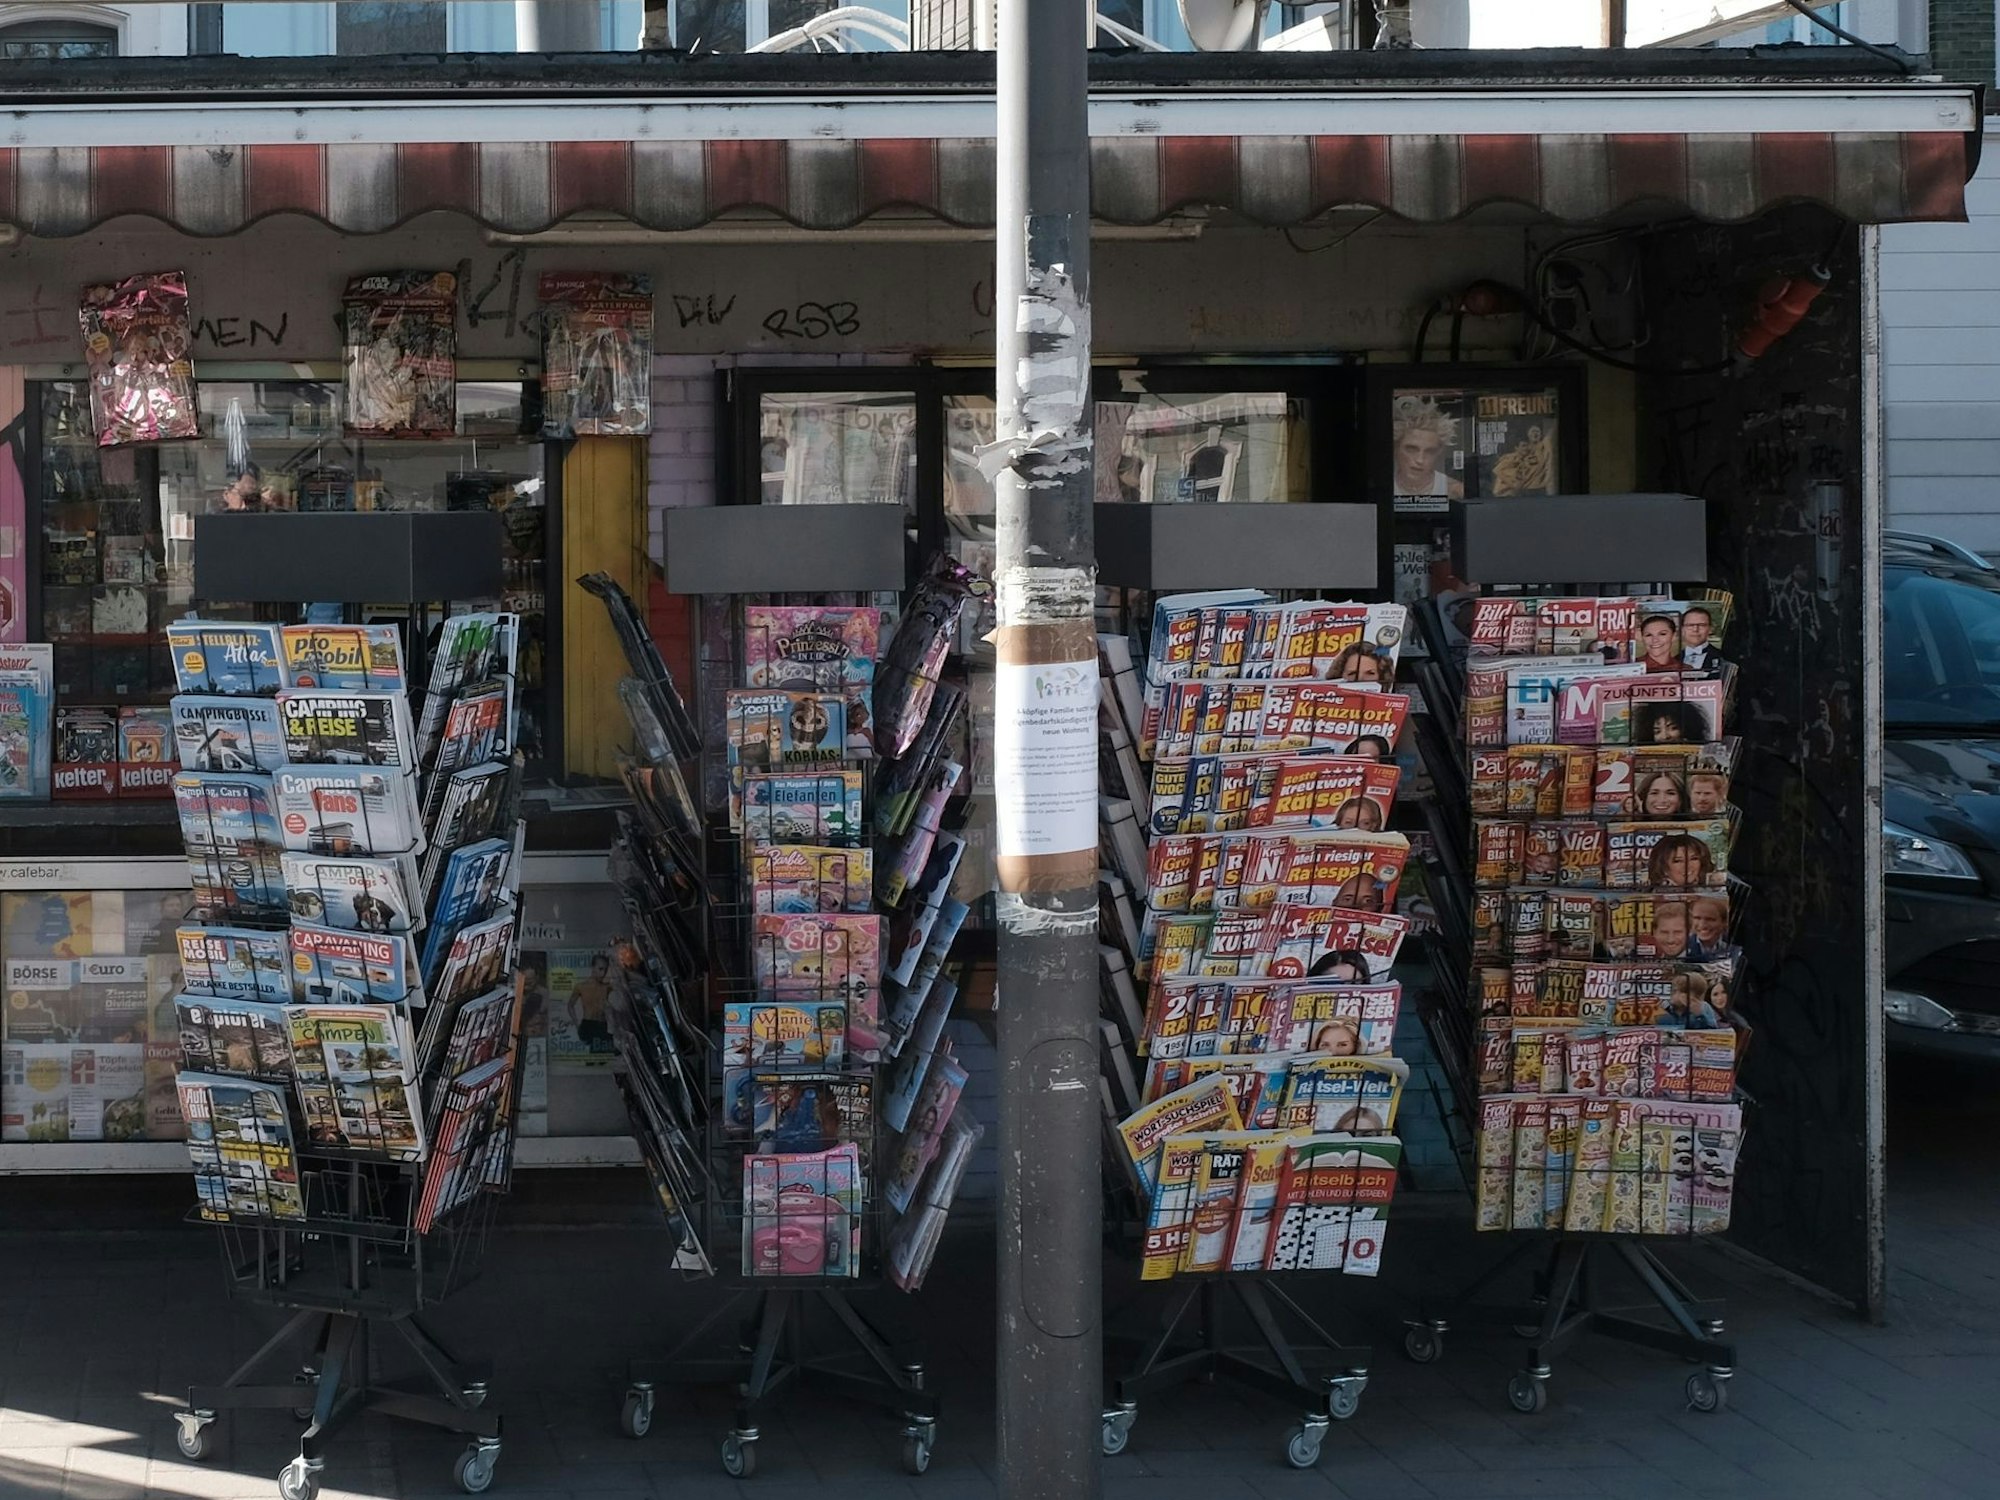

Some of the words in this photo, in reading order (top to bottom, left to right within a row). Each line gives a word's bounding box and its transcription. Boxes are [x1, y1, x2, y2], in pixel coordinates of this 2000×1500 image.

[1475, 603, 1514, 622] Bild
[1542, 605, 1592, 626] tina
[295, 636, 330, 656] pro
[1290, 626, 1361, 659] Rätsel
[304, 647, 364, 666] mobil
[180, 707, 268, 723] CAMPINGBUSSE
[285, 699, 368, 719] CAMPING
[1296, 700, 1393, 722] Kreuzwort
[306, 718, 358, 737] REISE
[55, 767, 106, 789] kelter
[121, 767, 172, 788] kelter
[1280, 775, 1364, 797] Kreuzwort
[775, 789, 837, 802] Elefanten
[1275, 788, 1352, 814] Rätsel
[293, 931, 391, 960] CARAVANING
[13, 962, 57, 980] BÖRSE
[1691, 1069, 1731, 1081] rößten
[1134, 1094, 1222, 1143] WORT-SUCHSPIEL
